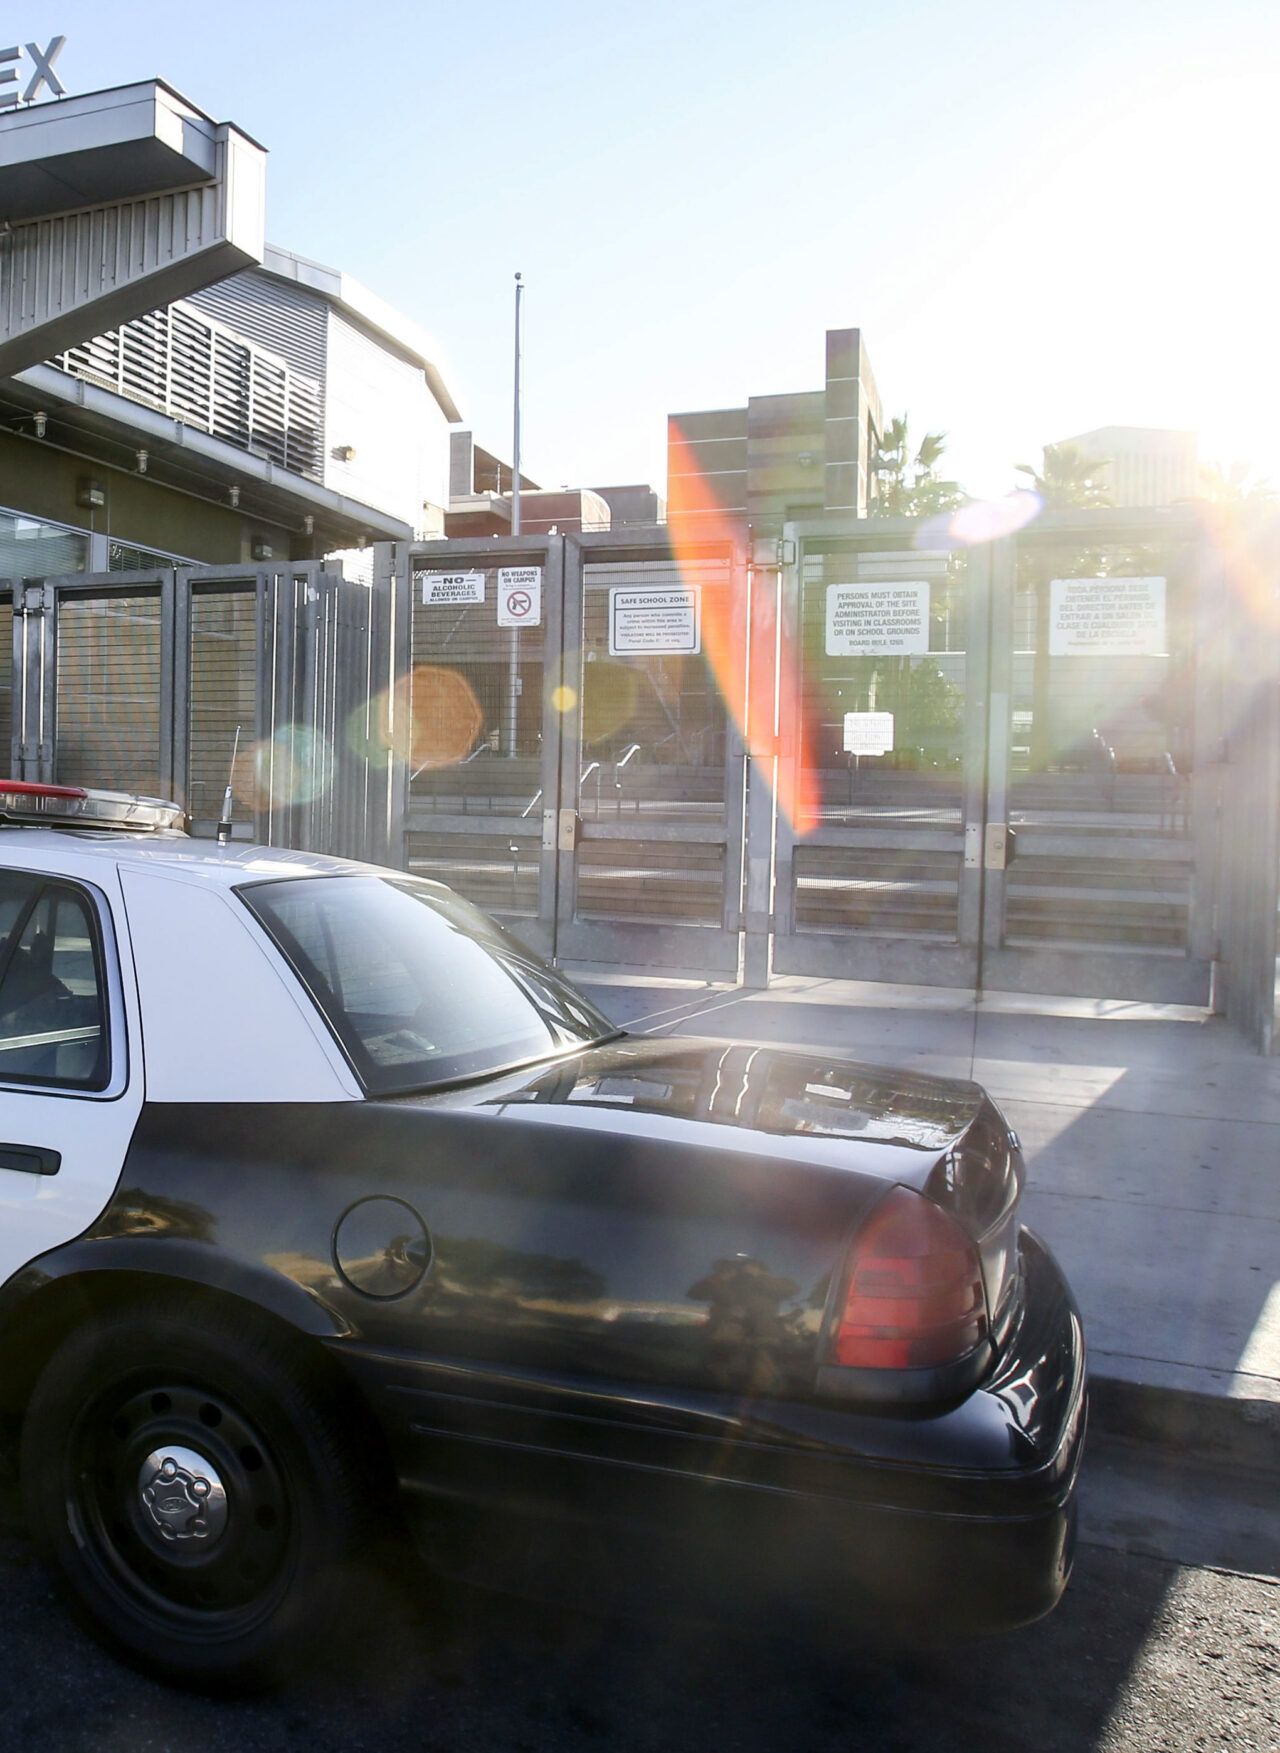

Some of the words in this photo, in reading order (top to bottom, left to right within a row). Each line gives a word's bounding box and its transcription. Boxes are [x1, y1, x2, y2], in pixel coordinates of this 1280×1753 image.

[837, 592, 869, 600] PERSONS
[870, 591, 890, 599] MUST
[892, 591, 918, 599] OBTAIN
[838, 601, 874, 609] APPROVAL
[834, 610, 891, 618] ADMINISTRATOR
[892, 609, 920, 617] BEFORE
[832, 619, 862, 627] VISITING
[864, 619, 872, 627] IN
[873, 618, 922, 627] CLASSROOMS
[834, 629, 844, 637] OR
[856, 628, 885, 636] SCHOOL
[886, 627, 920, 635] GROUNDS
